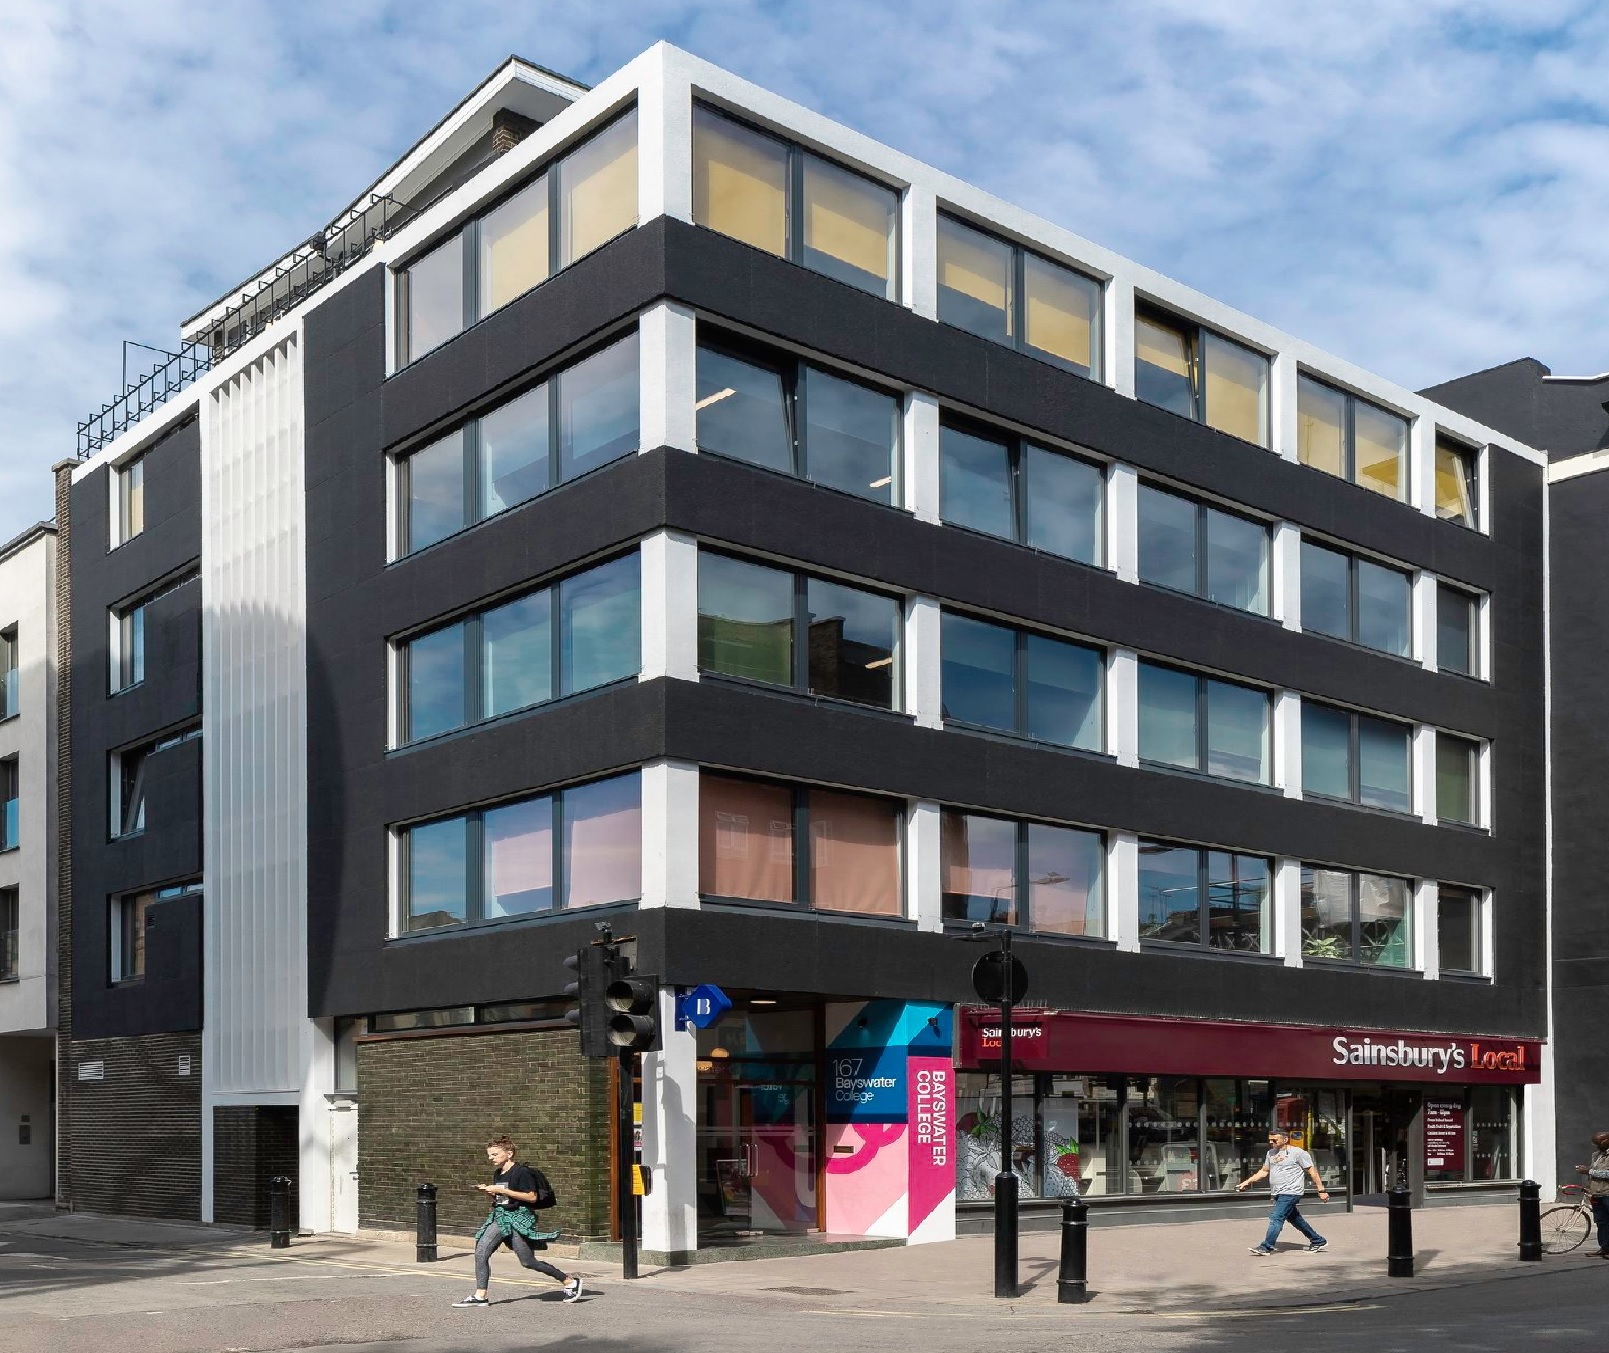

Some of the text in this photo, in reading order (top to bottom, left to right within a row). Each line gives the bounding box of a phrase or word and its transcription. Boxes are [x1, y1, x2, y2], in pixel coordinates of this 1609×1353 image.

[982, 1027, 1042, 1038] Saibury's
[982, 1038, 1002, 1047] Loc
[1332, 1036, 1526, 1075] Sainsbury's Local
[832, 1058, 863, 1077] 167
[835, 1076, 897, 1091] Bayswater
[835, 1089, 875, 1104] College
[917, 1070, 931, 1144] COLLEGE
[932, 1070, 947, 1167] BAYSWATER
